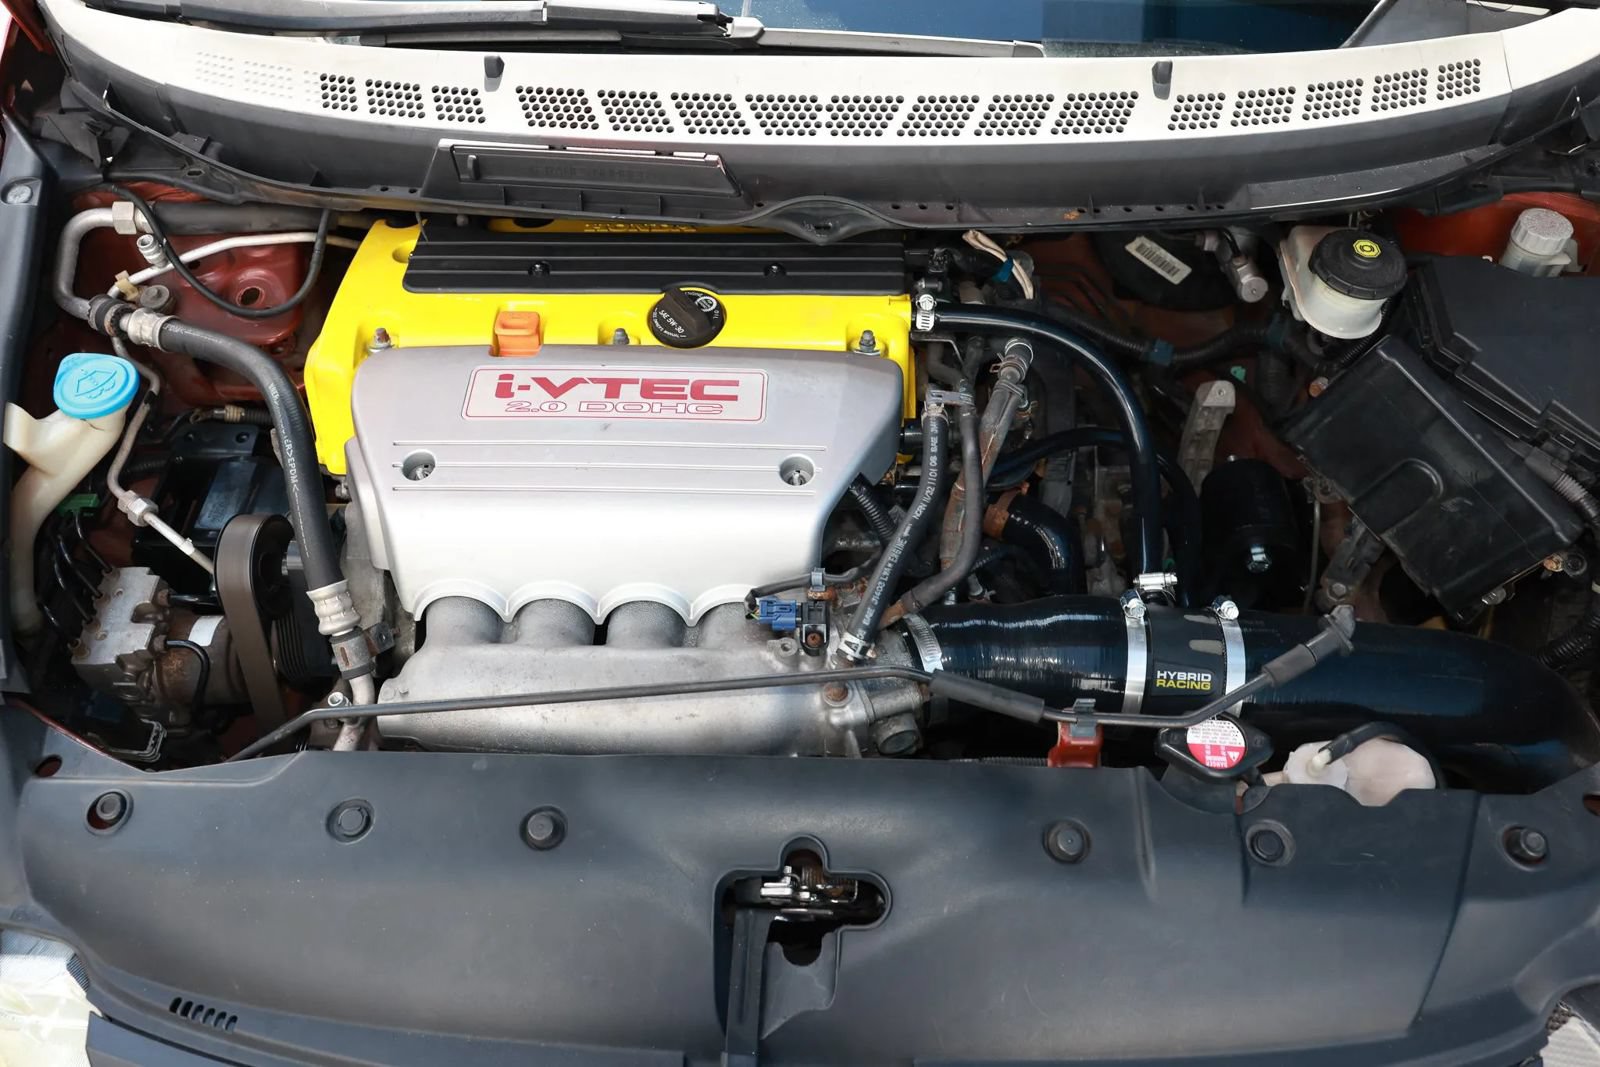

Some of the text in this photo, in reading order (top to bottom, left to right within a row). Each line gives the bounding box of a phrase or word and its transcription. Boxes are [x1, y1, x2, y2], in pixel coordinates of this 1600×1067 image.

[495, 373, 740, 401] i-VTEC
[505, 400, 723, 415] 2.0 DOHC
[1157, 670, 1212, 682] HYBRID
[1156, 679, 1211, 690] RACING
